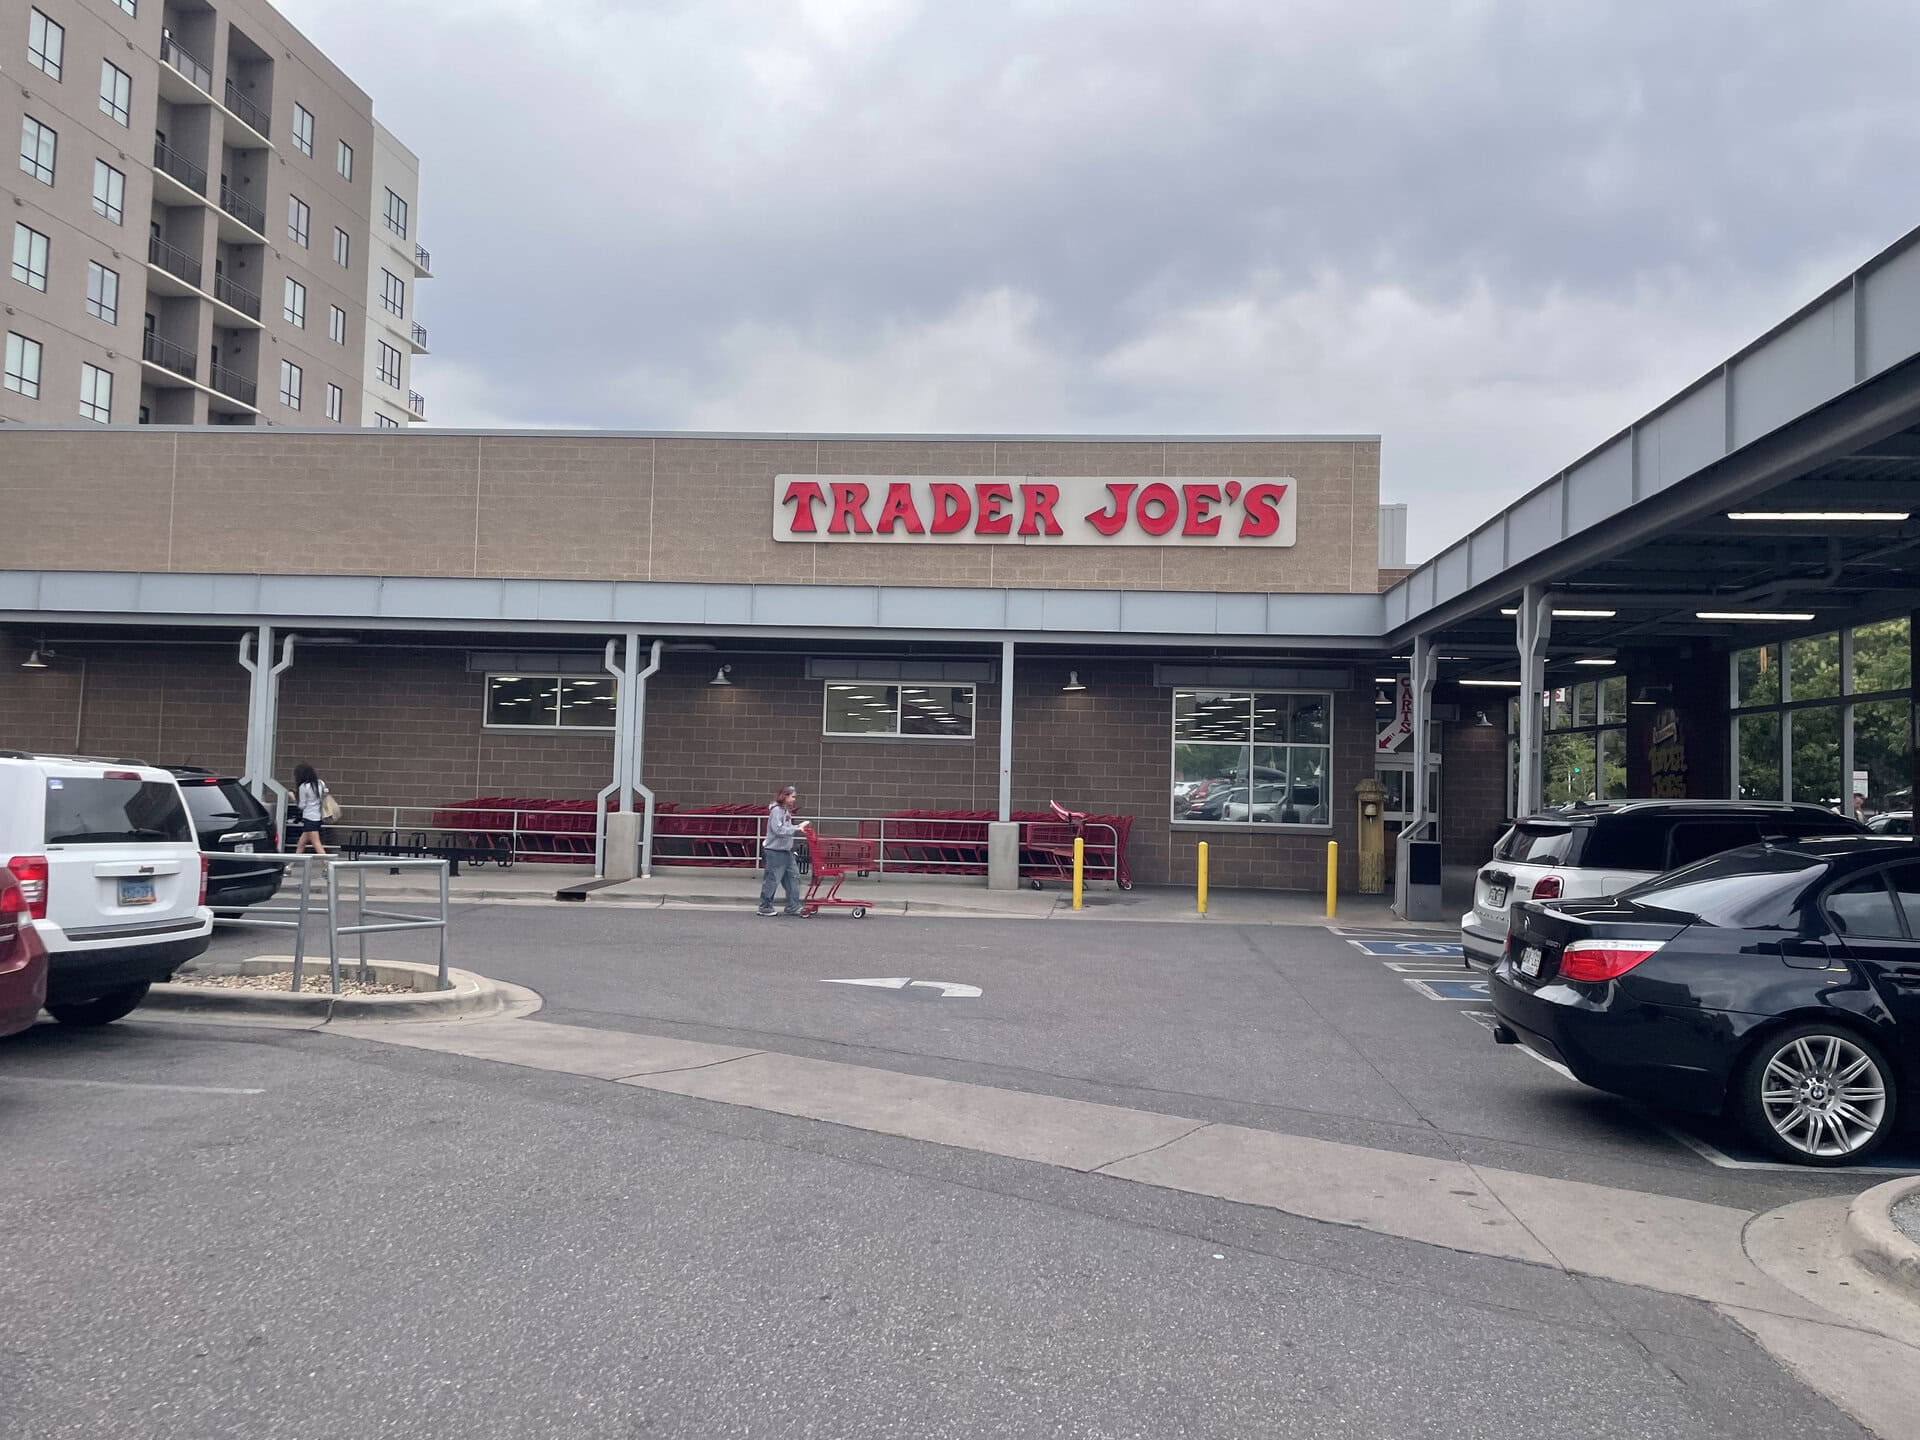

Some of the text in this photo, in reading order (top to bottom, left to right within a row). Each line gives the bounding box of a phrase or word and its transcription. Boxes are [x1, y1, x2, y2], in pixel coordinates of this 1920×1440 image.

[782, 480, 1289, 538] TRADER JOE'S
[1399, 676, 1413, 734] CARTS
